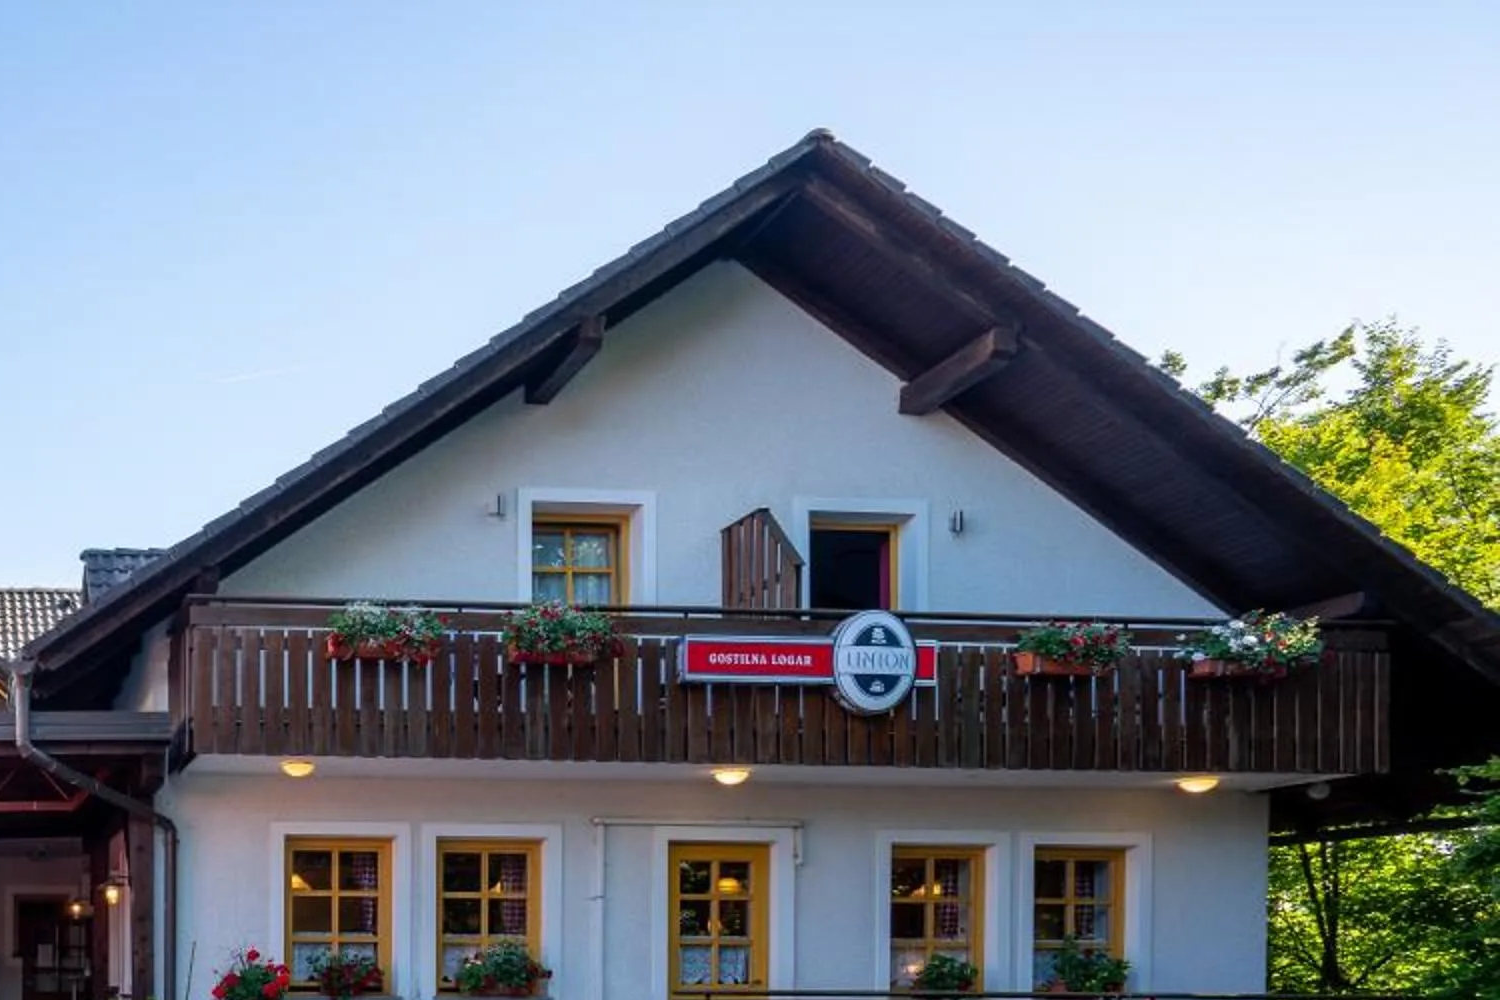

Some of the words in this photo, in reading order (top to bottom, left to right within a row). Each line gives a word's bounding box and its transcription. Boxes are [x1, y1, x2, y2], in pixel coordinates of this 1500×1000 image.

[708, 652, 767, 666] GOSTILNA
[772, 653, 813, 666] LOGAR
[847, 650, 910, 671] UNION
